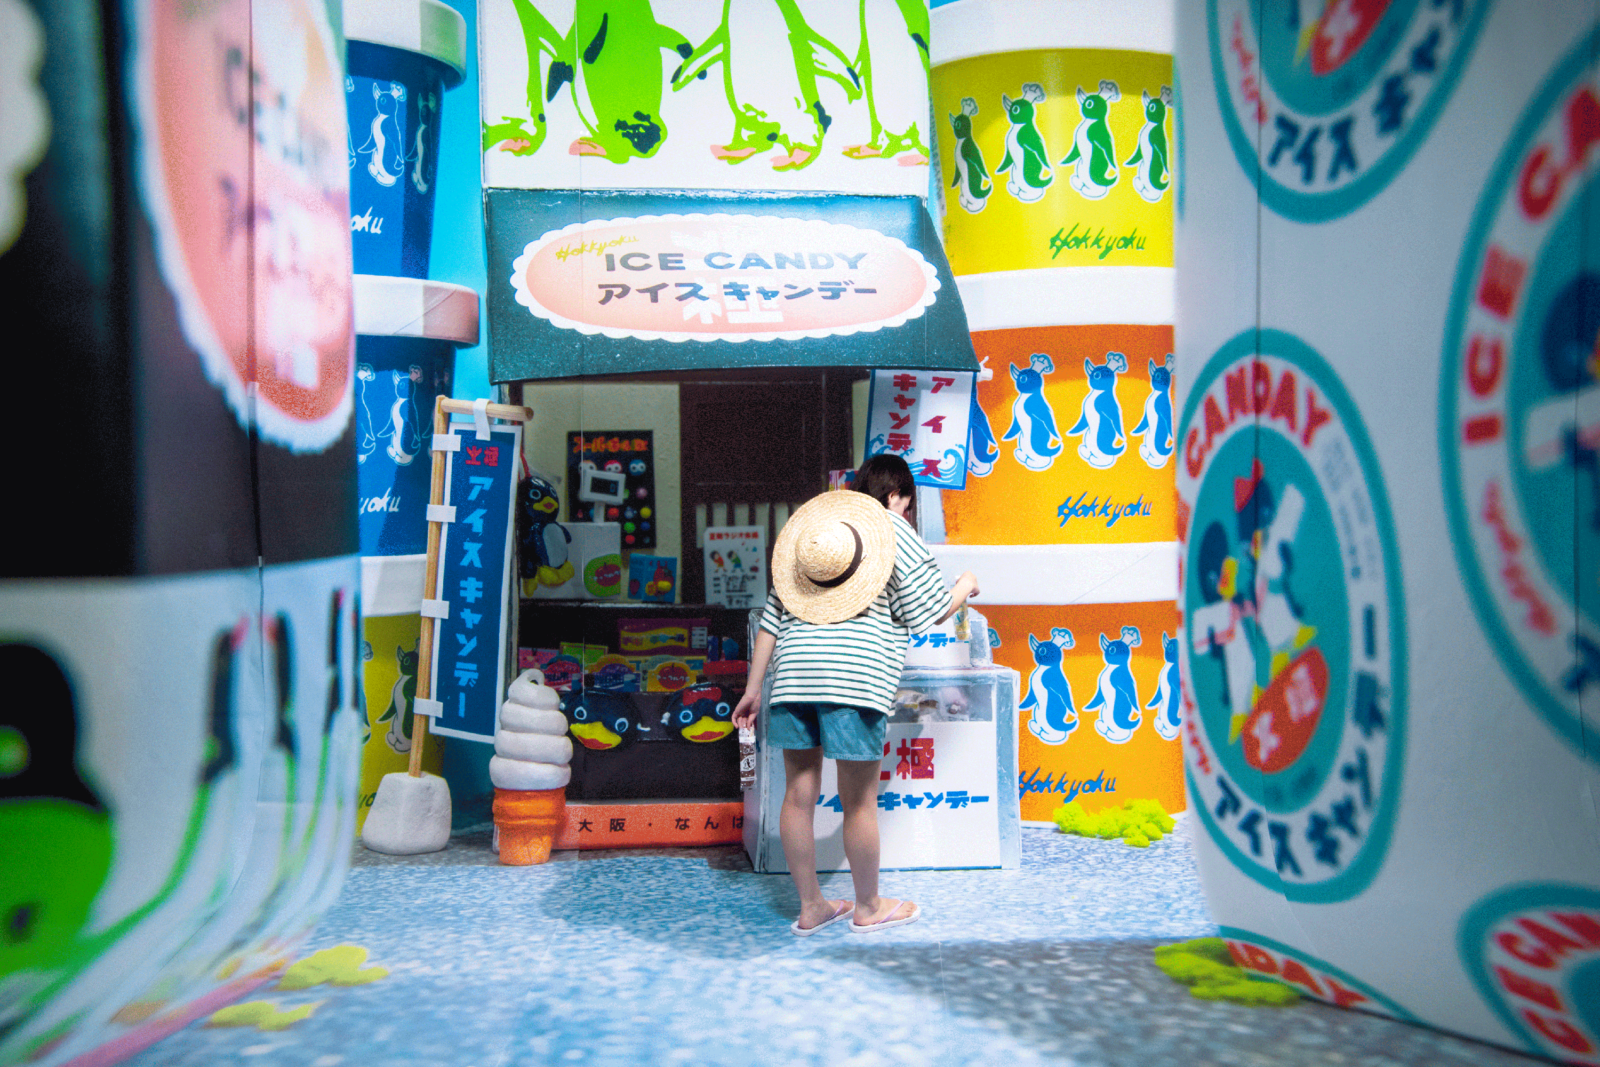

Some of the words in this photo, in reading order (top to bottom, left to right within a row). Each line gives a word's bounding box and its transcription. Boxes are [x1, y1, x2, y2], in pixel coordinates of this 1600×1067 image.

[556, 235, 640, 262] Hokkyoku
[1049, 222, 1147, 260] Hokkyoku
[605, 252, 686, 272] ICE
[703, 251, 868, 271] CANDY
[598, 279, 878, 305] アイスキャンデー
[917, 376, 956, 478] アイス
[1056, 491, 1153, 528] Hokkyoku
[453, 475, 495, 719] アイスキャンデー
[879, 737, 935, 782] 極
[1018, 766, 1117, 805] Hokkyoku
